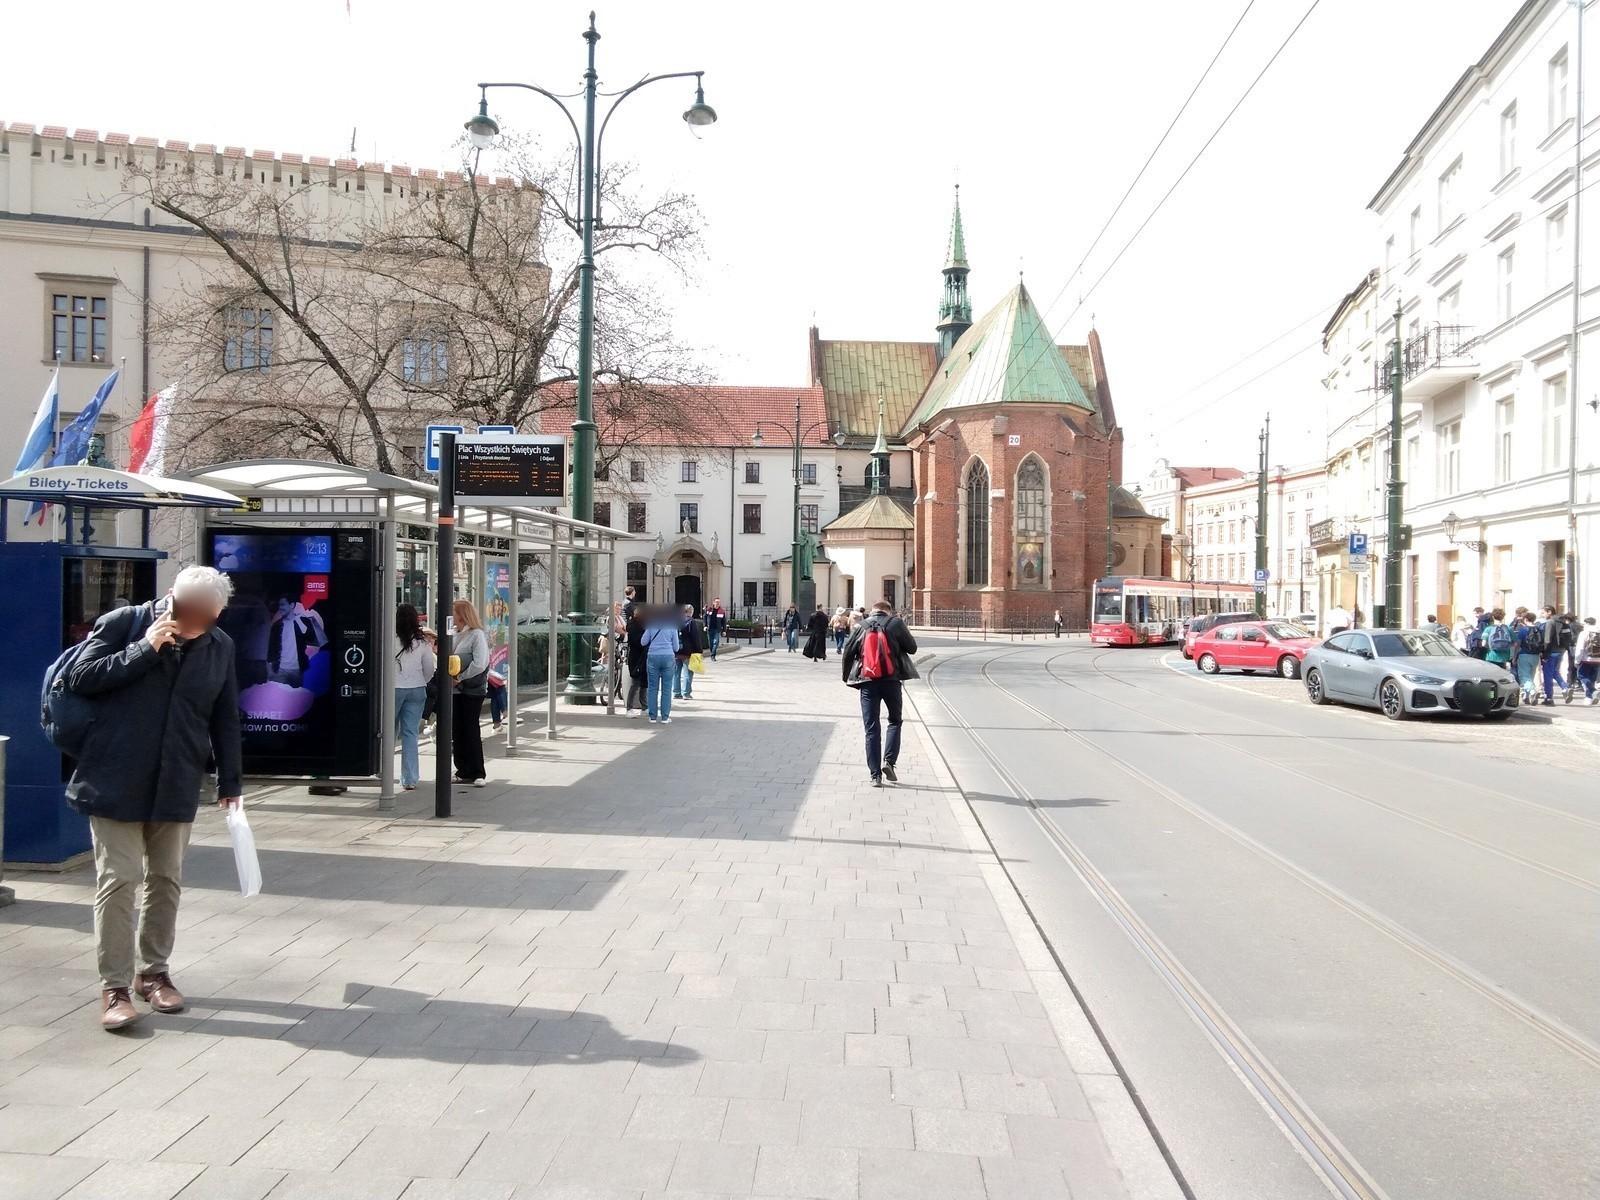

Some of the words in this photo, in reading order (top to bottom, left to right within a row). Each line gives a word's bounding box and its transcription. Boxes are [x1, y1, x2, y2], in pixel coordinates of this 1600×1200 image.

[458, 444, 473, 453] Plac
[473, 444, 510, 455] Wszystkich
[511, 444, 541, 455] Świętych
[542, 446, 550, 454] 02
[29, 477, 129, 490] Bilety-Tickets
